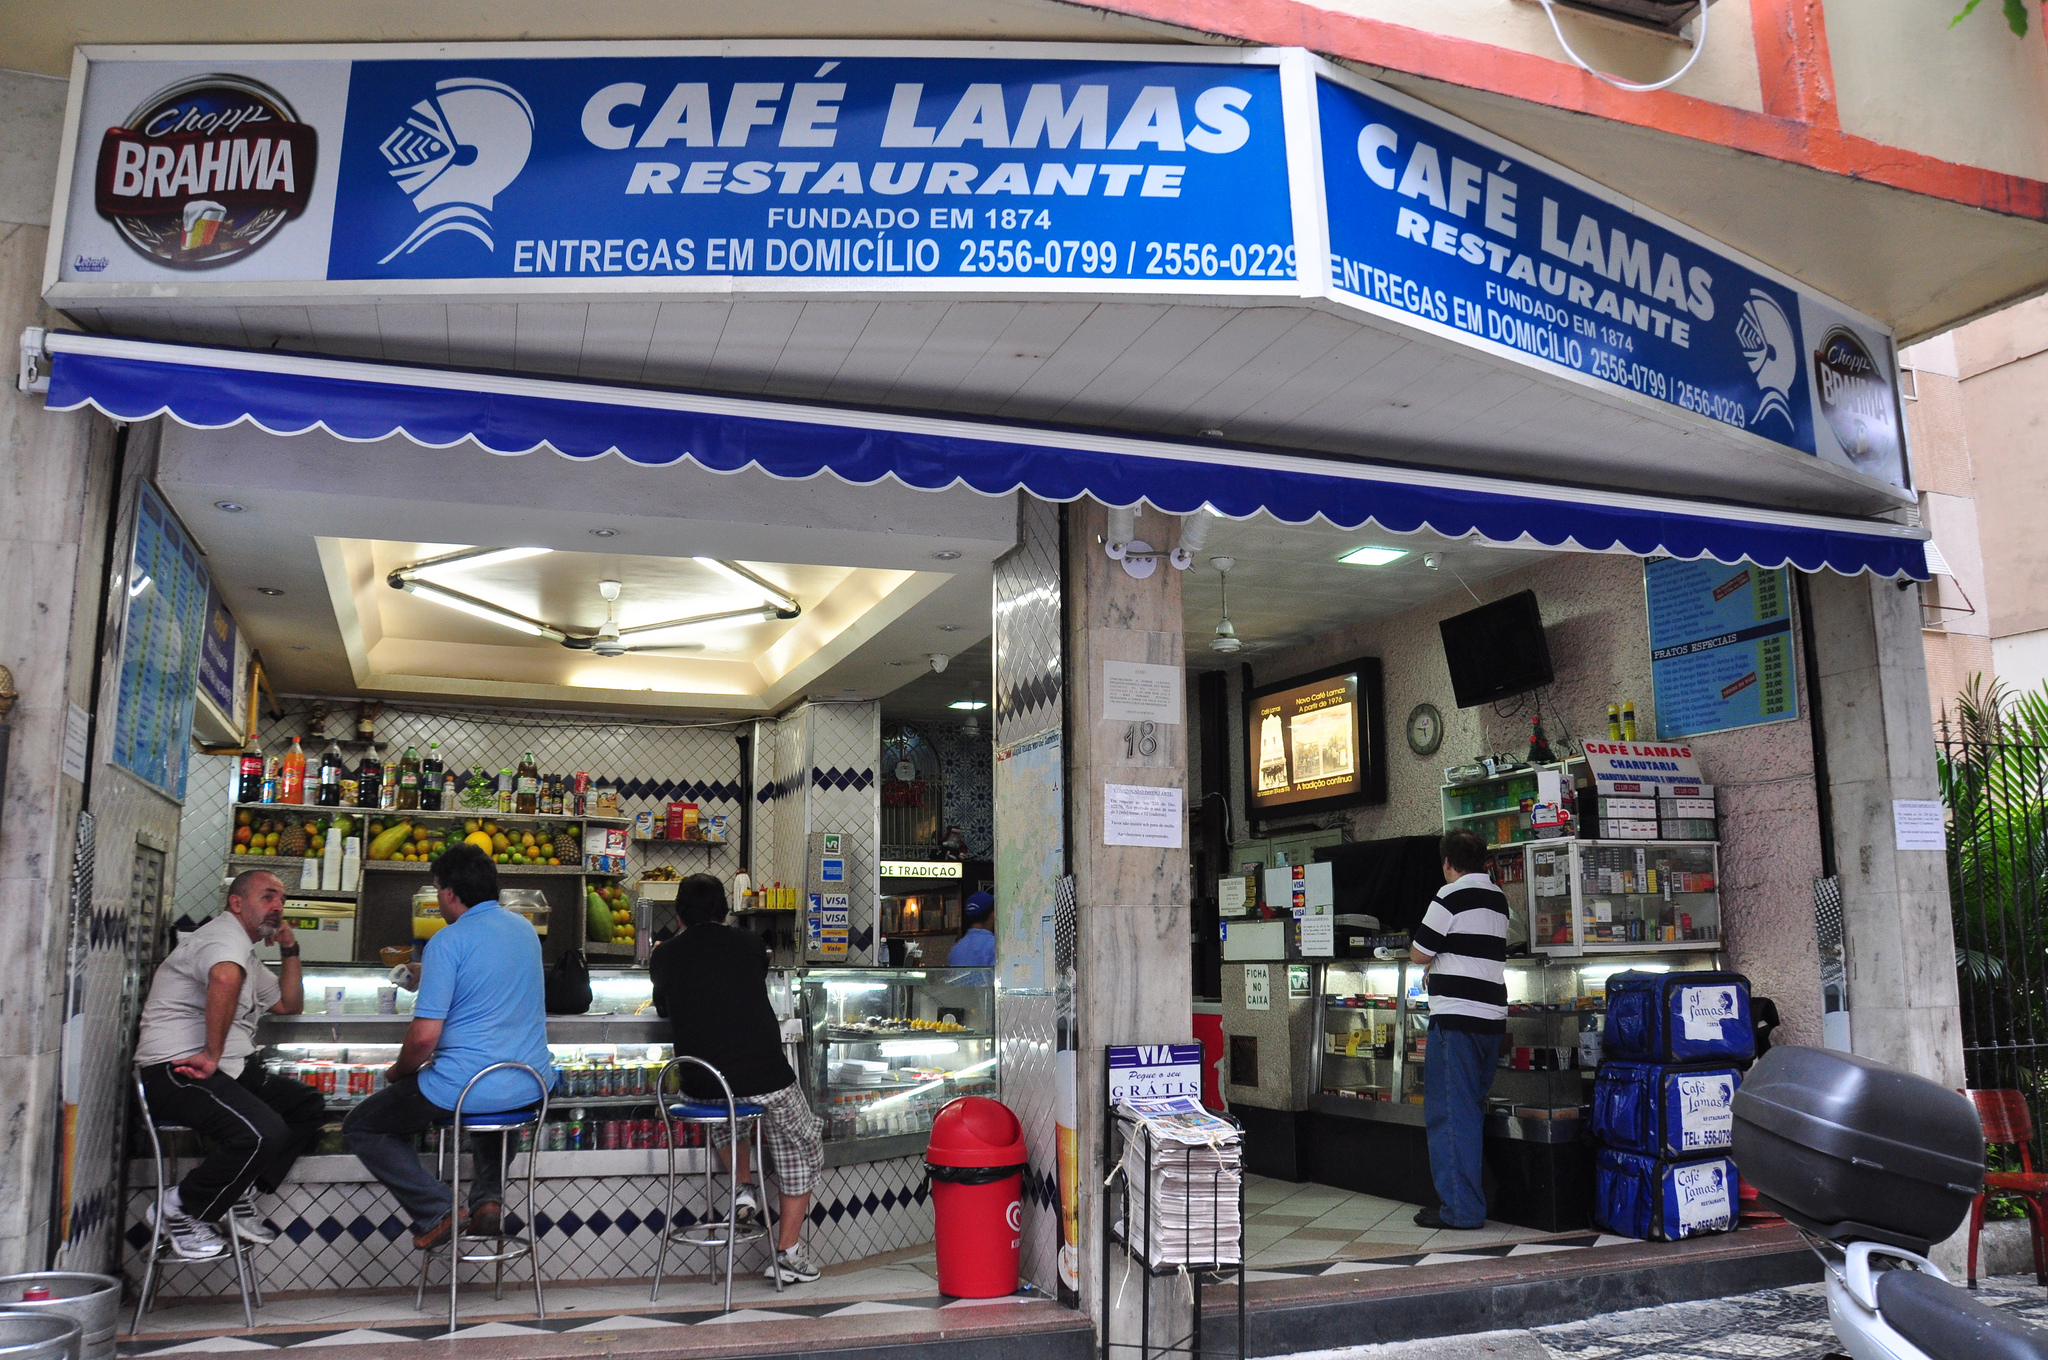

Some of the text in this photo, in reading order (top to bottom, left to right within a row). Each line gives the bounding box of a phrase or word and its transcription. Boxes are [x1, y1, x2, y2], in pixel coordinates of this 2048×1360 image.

[581, 61, 1253, 155] CAFÉ LAMAS
[145, 105, 271, 137] Chopp
[113, 138, 295, 198] BRAHMA
[624, 161, 1186, 198] RESTAURANTE
[768, 207, 1051, 231] FUNDADO EM 1874
[1357, 123, 1715, 322] CAFÉ LAMAS
[514, 238, 695, 273] ENTREGAS
[706, 238, 754, 272] EM
[765, 231, 939, 273] DOMICÍLIO
[959, 239, 1117, 274] 2556-0799
[1146, 242, 1298, 277] 2556-0229
[1396, 206, 1690, 349] RESTAURANTE
[1486, 281, 1634, 353] FUNDADO EM 1874
[1331, 253, 1448, 322] ENTREGAS
[1453, 296, 1483, 335] EM
[1488, 309, 1582, 369] DOMICÍLIO
[1590, 347, 1667, 400] 2556-0799
[1678, 380, 1746, 429] 2556-0229
[1827, 346, 1871, 373] Chopp
[1654, 633, 1738, 660] PRATOS ESPECIAIS
[1296, 687, 1346, 705] Novo Café Lamas
[1304, 703, 1318, 713] partir
[1328, 696, 1343, 705] 1976
[1124, 720, 1157, 759] 18
[1585, 742, 1692, 758] CAFÉ LAMAS
[1610, 759, 1679, 771] CHARUTARIA
[1326, 775, 1353, 786] continua
[1597, 773, 1628, 781] CHARUTOS
[1666, 776, 1702, 785] IMPORTADOS
[880, 866, 894, 875] DE
[1294, 881, 1304, 889] VISA
[825, 896, 847, 905] VISA
[300, 919, 317, 929] RJ
[825, 914, 847, 923] VISA
[1246, 969, 1267, 979] FICHA
[1252, 983, 1262, 992] NO
[1247, 995, 1269, 1005] CAIXA
[1137, 1045, 1173, 1065] VIA
[1129, 1070, 1156, 1082] Pegue
[1112, 1081, 1198, 1098] GRÁTIS
[1682, 1081, 1706, 1097] Café
[1687, 1096, 1722, 1115] Lamas
[1684, 1131, 1700, 1146] TEL:
[1678, 1169, 1699, 1186] Café
[1684, 1185, 1716, 1206] Lamas
